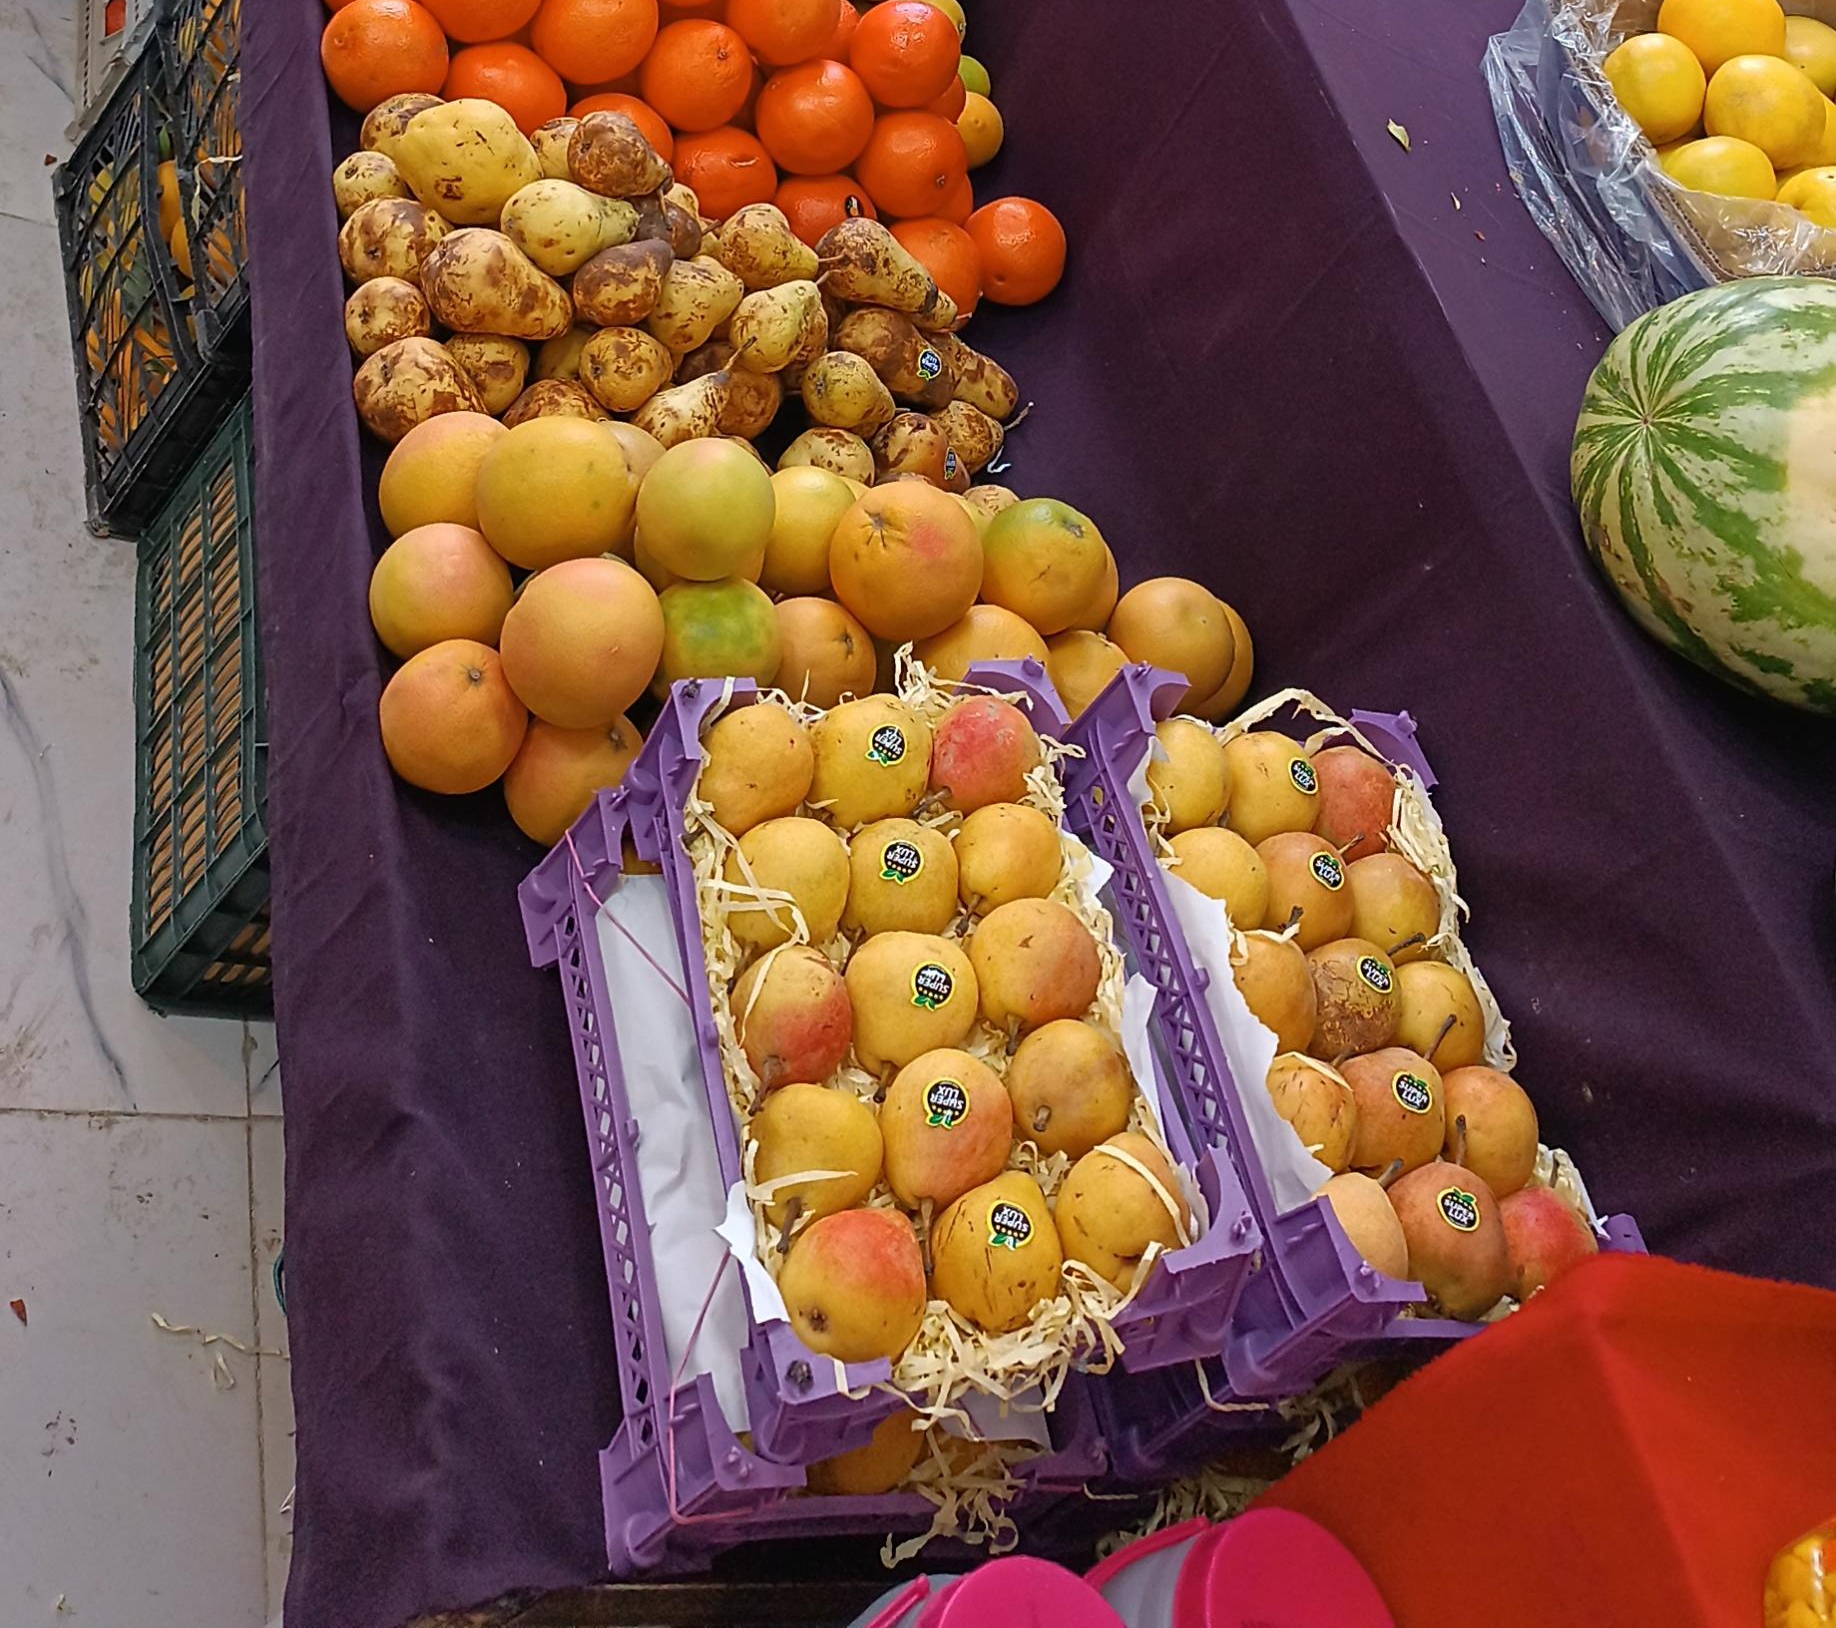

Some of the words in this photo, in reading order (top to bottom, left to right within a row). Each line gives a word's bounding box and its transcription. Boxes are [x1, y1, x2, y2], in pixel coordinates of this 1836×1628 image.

[874, 734, 903, 755] SUPER
[885, 729, 903, 745] LUX
[886, 850, 919, 869] SUPER
[894, 845, 916, 858] LUX
[917, 975, 950, 994] SUPER
[937, 1085, 960, 1099] LUX
[1398, 1080, 1429, 1104] SUPER
[1402, 1090, 1421, 1107] LUX
[929, 1093, 965, 1110] SUPER
[1001, 1206, 1024, 1222] LUX
[1443, 1198, 1475, 1221] SUPER
[1448, 1208, 1469, 1225] LUX
[994, 1212, 1030, 1233] SUPER
